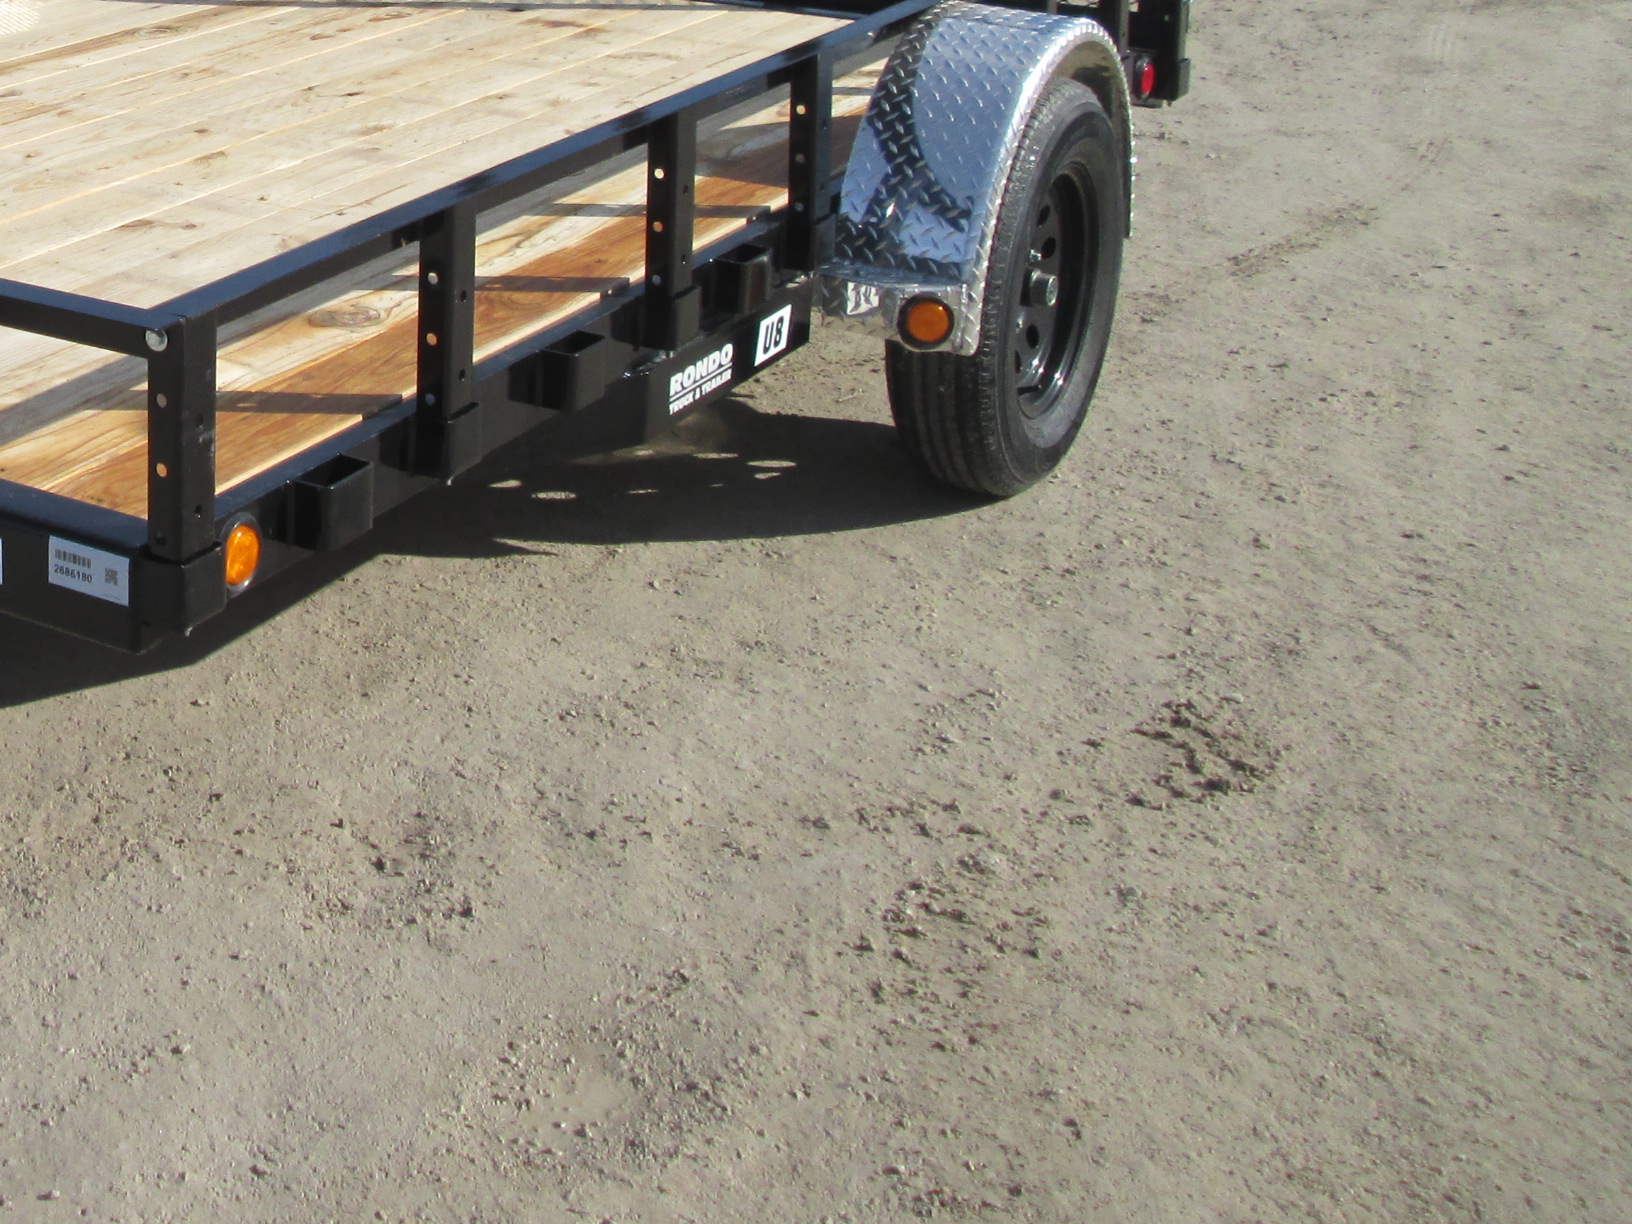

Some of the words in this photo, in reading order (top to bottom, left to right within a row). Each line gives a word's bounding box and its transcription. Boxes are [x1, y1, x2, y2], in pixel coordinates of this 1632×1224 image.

[762, 315, 784, 355] U8
[669, 343, 734, 394] RONDO
[701, 368, 732, 396] TRAILER
